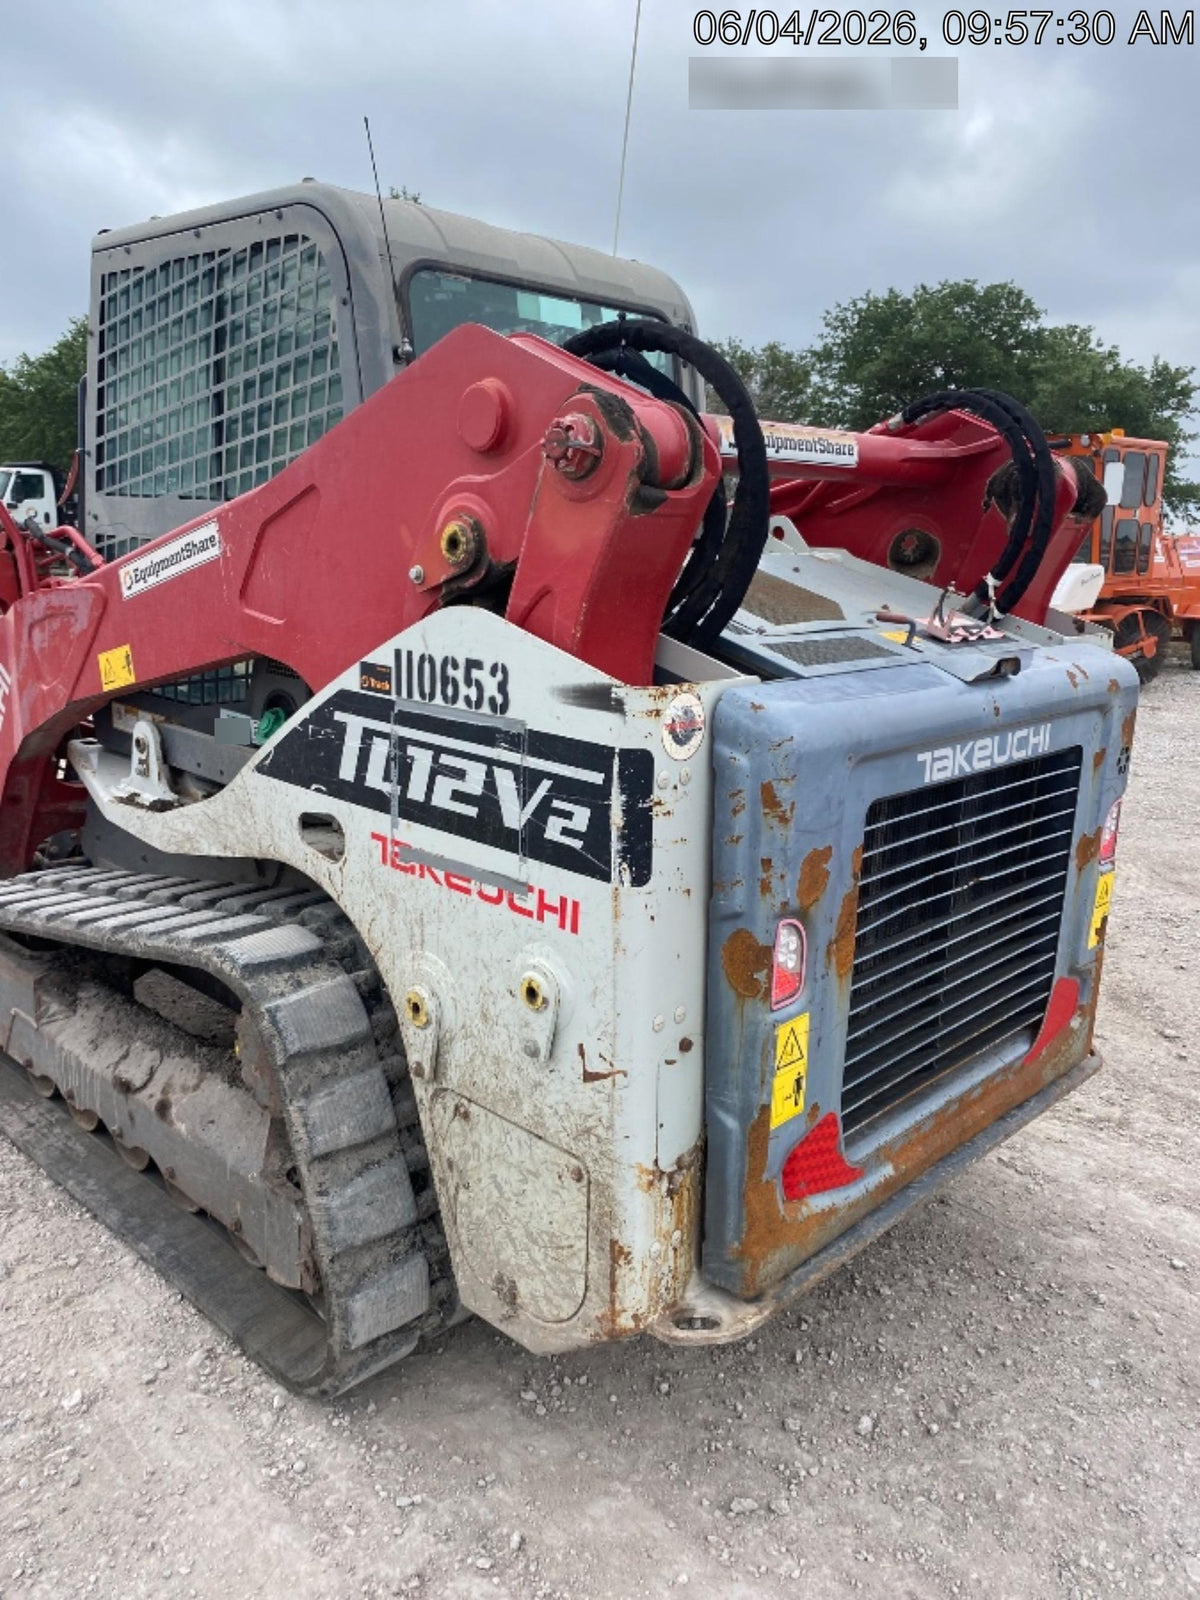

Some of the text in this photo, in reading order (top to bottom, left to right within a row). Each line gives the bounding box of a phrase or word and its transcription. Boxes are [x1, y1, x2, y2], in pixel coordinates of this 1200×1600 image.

[133, 534, 217, 583] EquipmentShare
[394, 648, 509, 716] 110653
[917, 723, 1051, 783] TAKEUCHI
